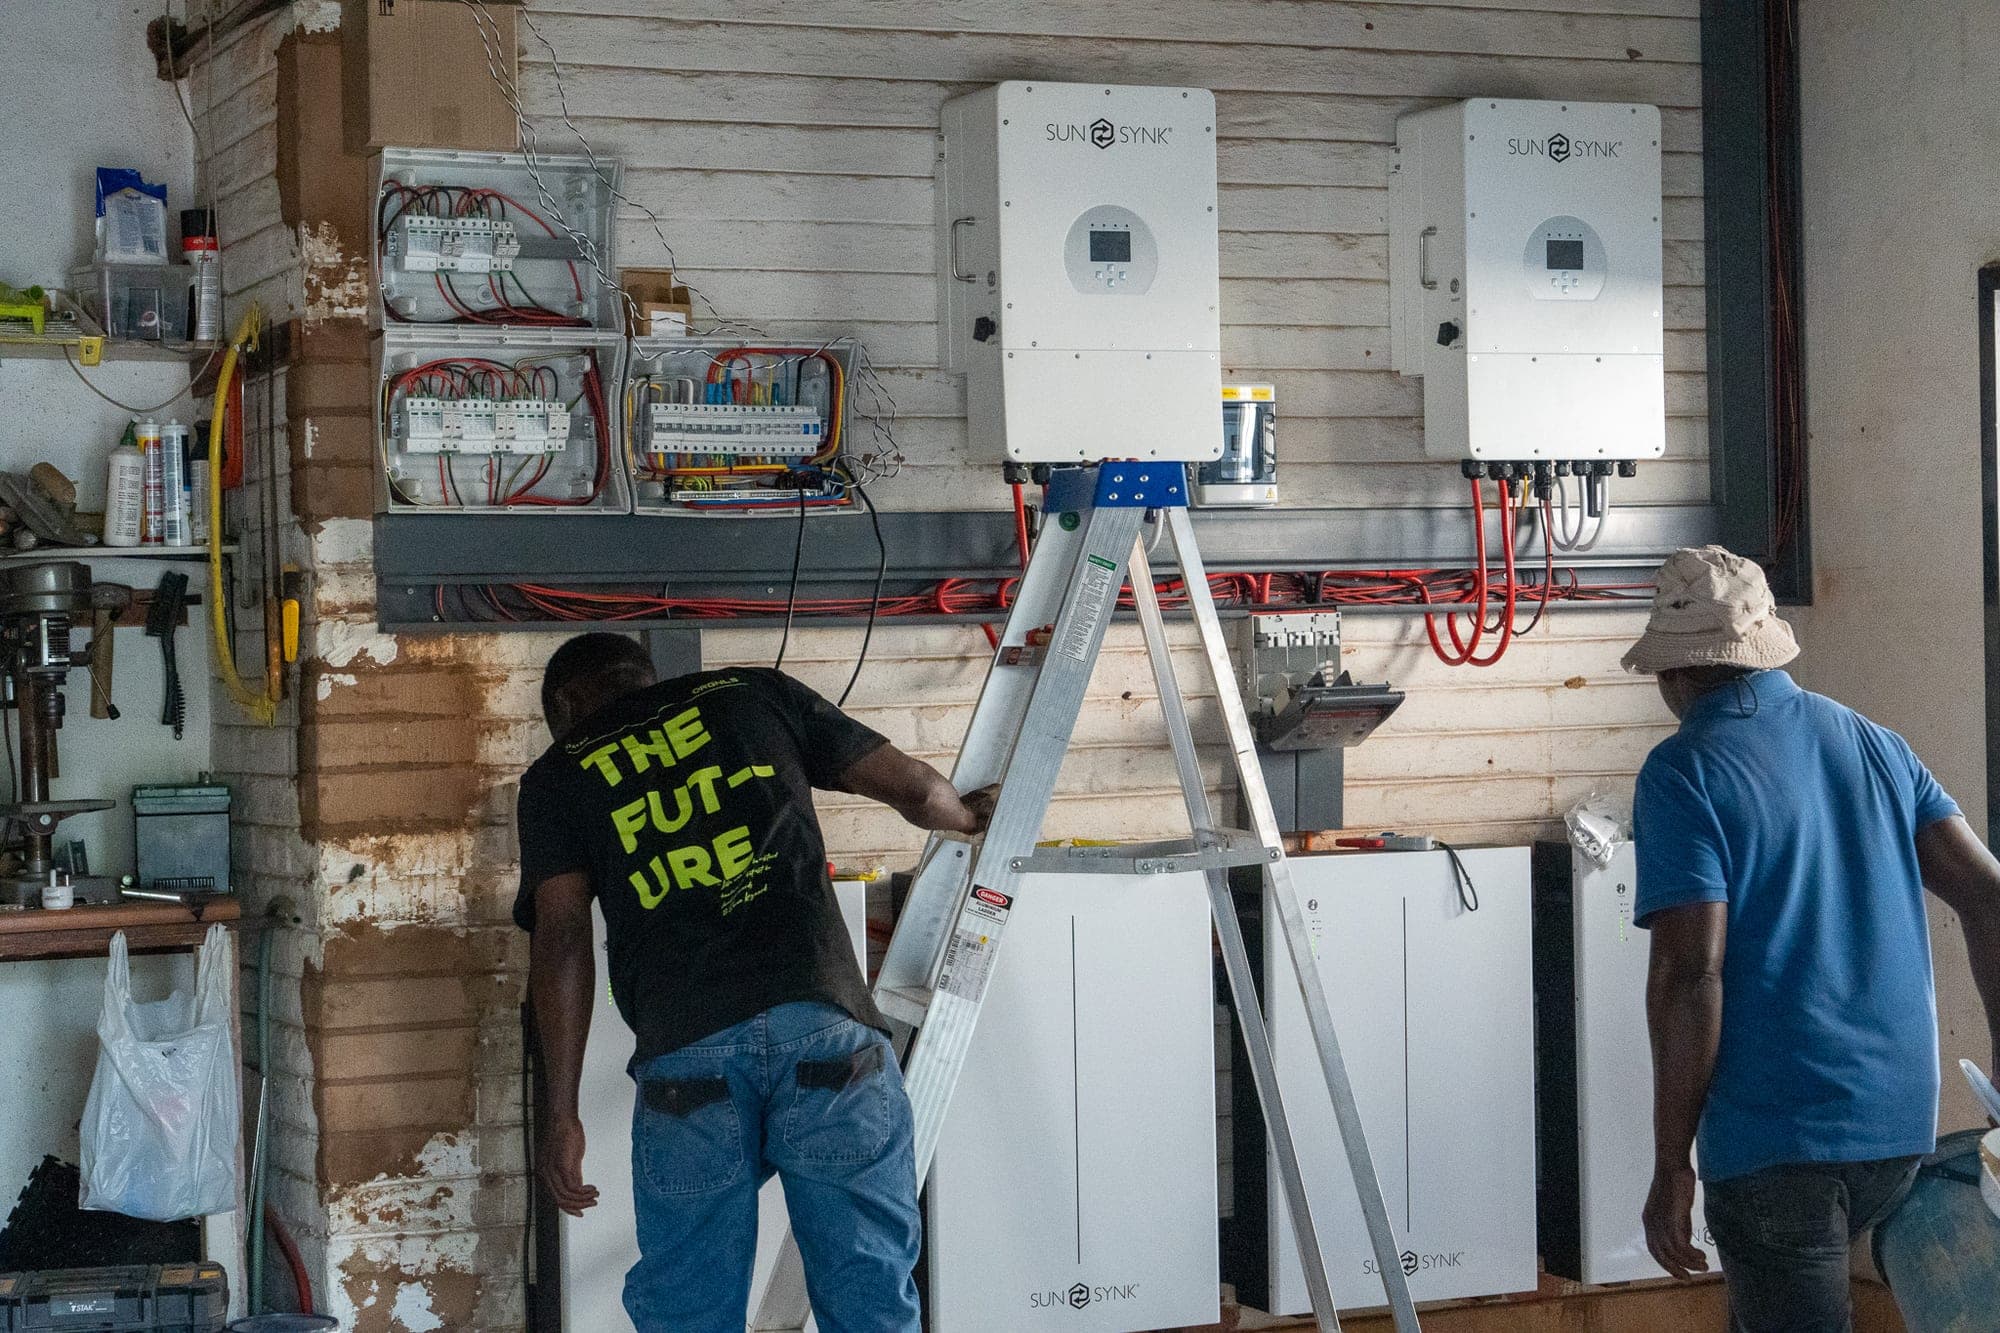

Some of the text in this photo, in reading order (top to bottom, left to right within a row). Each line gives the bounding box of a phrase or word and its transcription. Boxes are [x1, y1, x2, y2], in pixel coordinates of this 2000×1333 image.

[1046, 123, 1086, 141] SUN
[1508, 138, 1544, 155] SUN
[580, 706, 712, 788] THE
[628, 825, 753, 910] URE
[980, 891, 1004, 904] DANGER
[1363, 1259, 1381, 1274] SU
[1030, 1290, 1065, 1308] SUN
